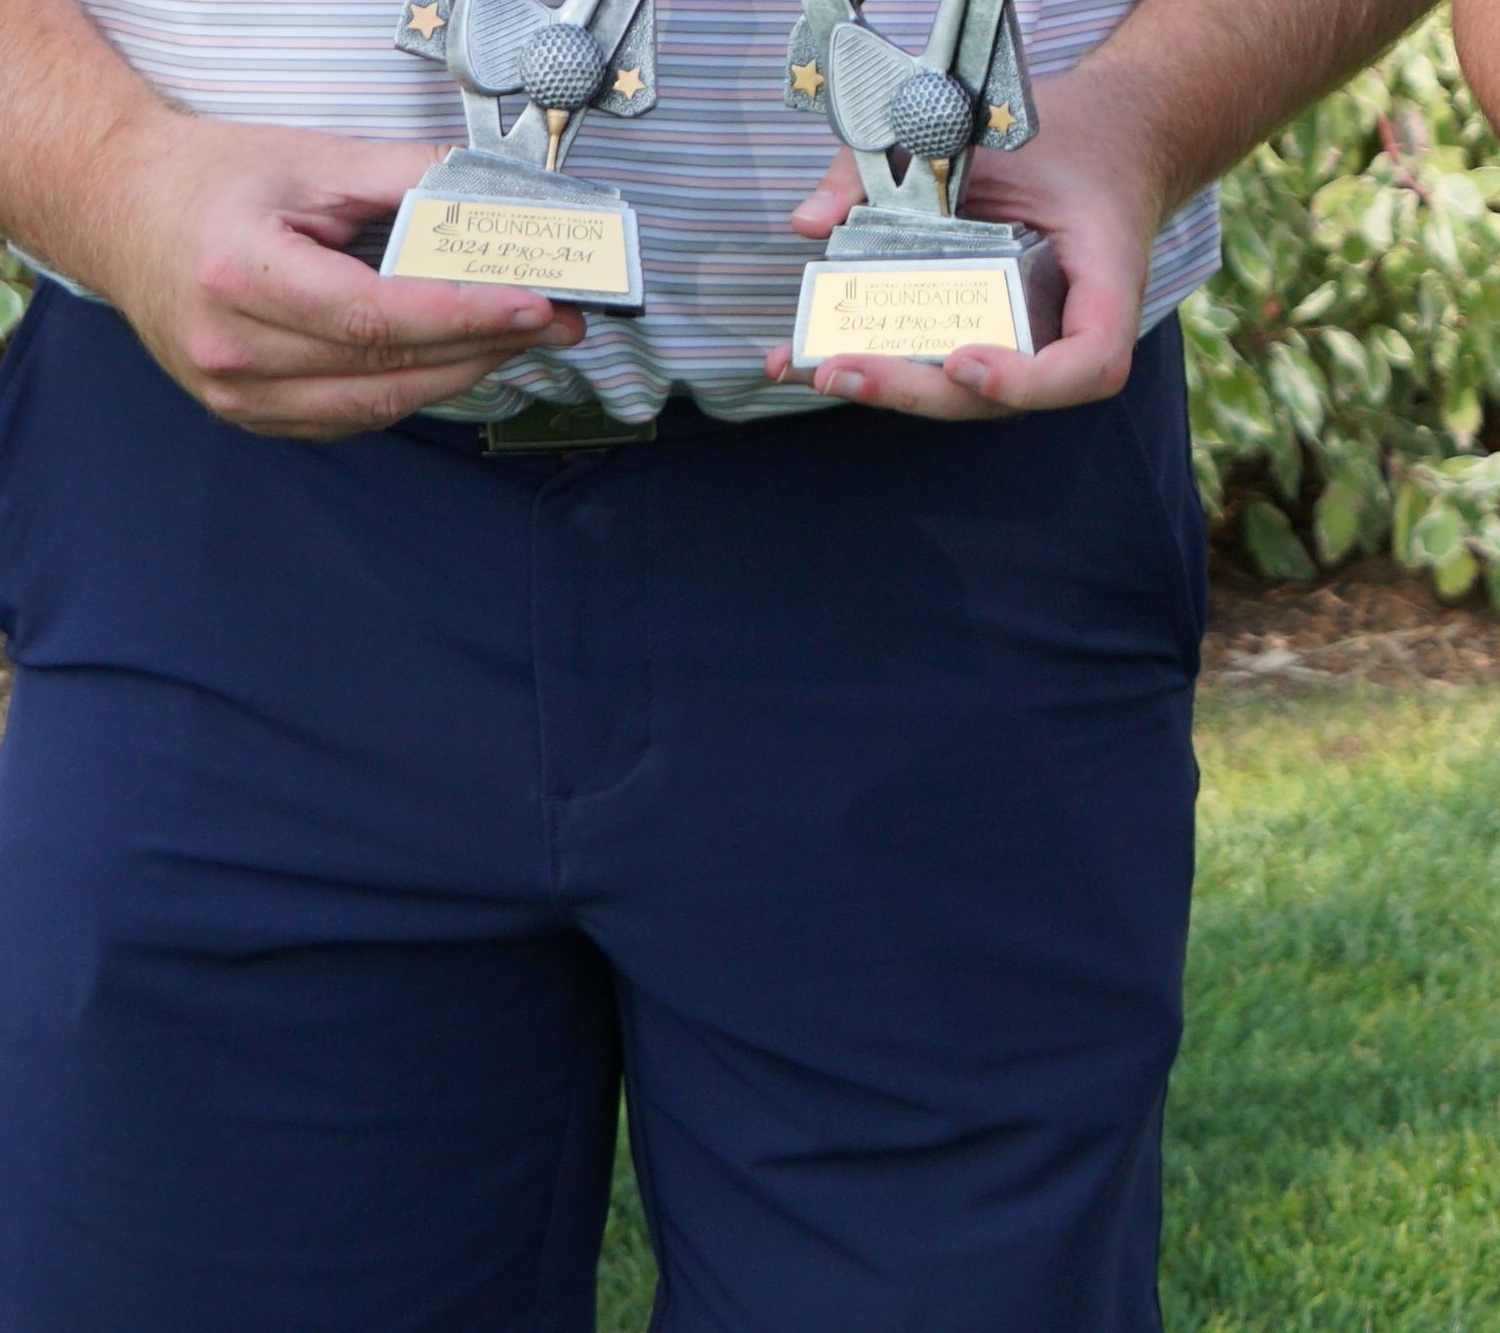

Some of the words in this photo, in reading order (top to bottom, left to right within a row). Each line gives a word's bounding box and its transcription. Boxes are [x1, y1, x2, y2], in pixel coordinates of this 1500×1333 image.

[466, 216, 604, 241] FOUNDATION
[435, 237, 491, 257] 2024
[463, 259, 510, 275] Low
[513, 262, 565, 280] Gross
[865, 288, 989, 307] FOUNDATION
[839, 315, 887, 331] 2024
[865, 336, 908, 351] Low
[911, 336, 956, 354] Gross
